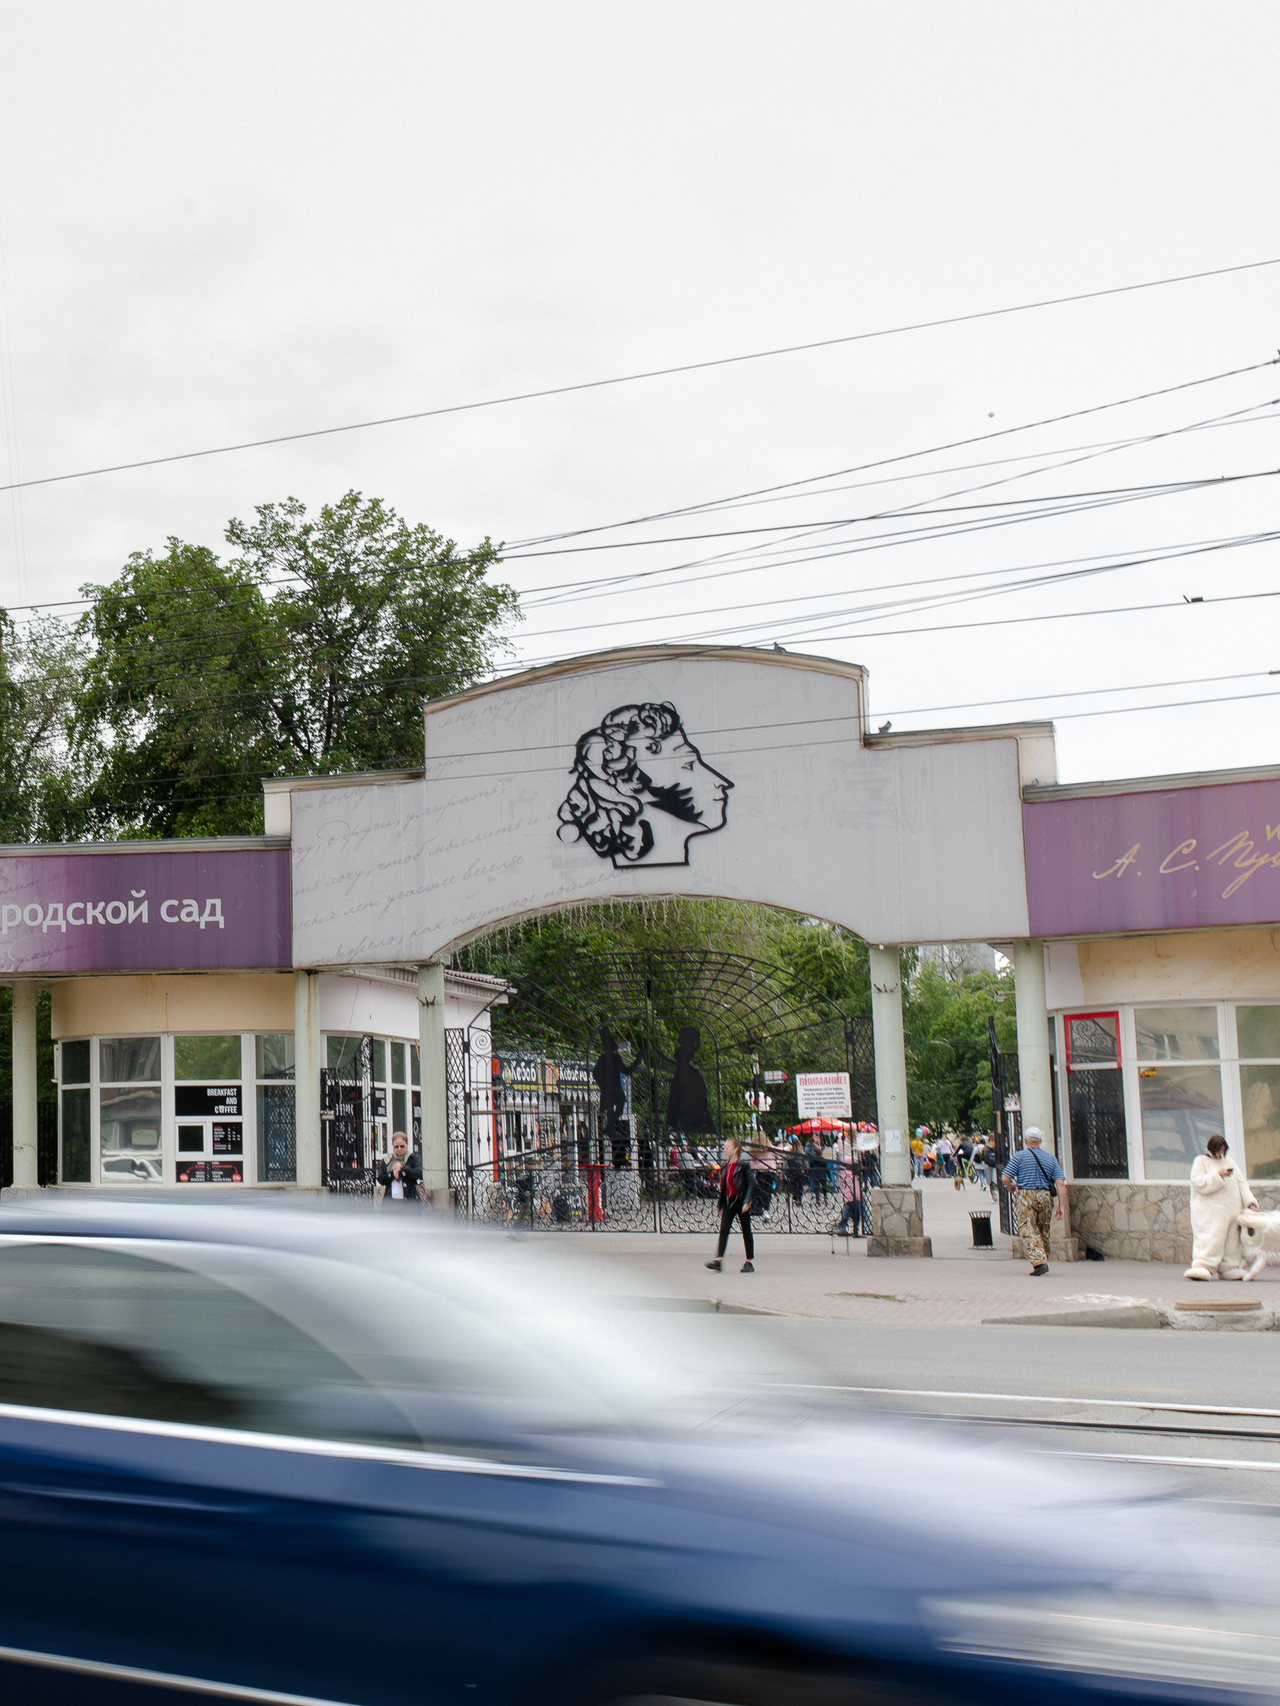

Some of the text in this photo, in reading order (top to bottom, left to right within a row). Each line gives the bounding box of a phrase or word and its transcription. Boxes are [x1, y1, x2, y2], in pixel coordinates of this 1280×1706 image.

[1159, 838, 1200, 875] С.
[160, 897, 225, 930] сад
[799, 1075, 847, 1087] ВНИМАНИЕ!
[206, 1087, 238, 1097] BREAKFAST
[225, 1096, 238, 1105] AND
